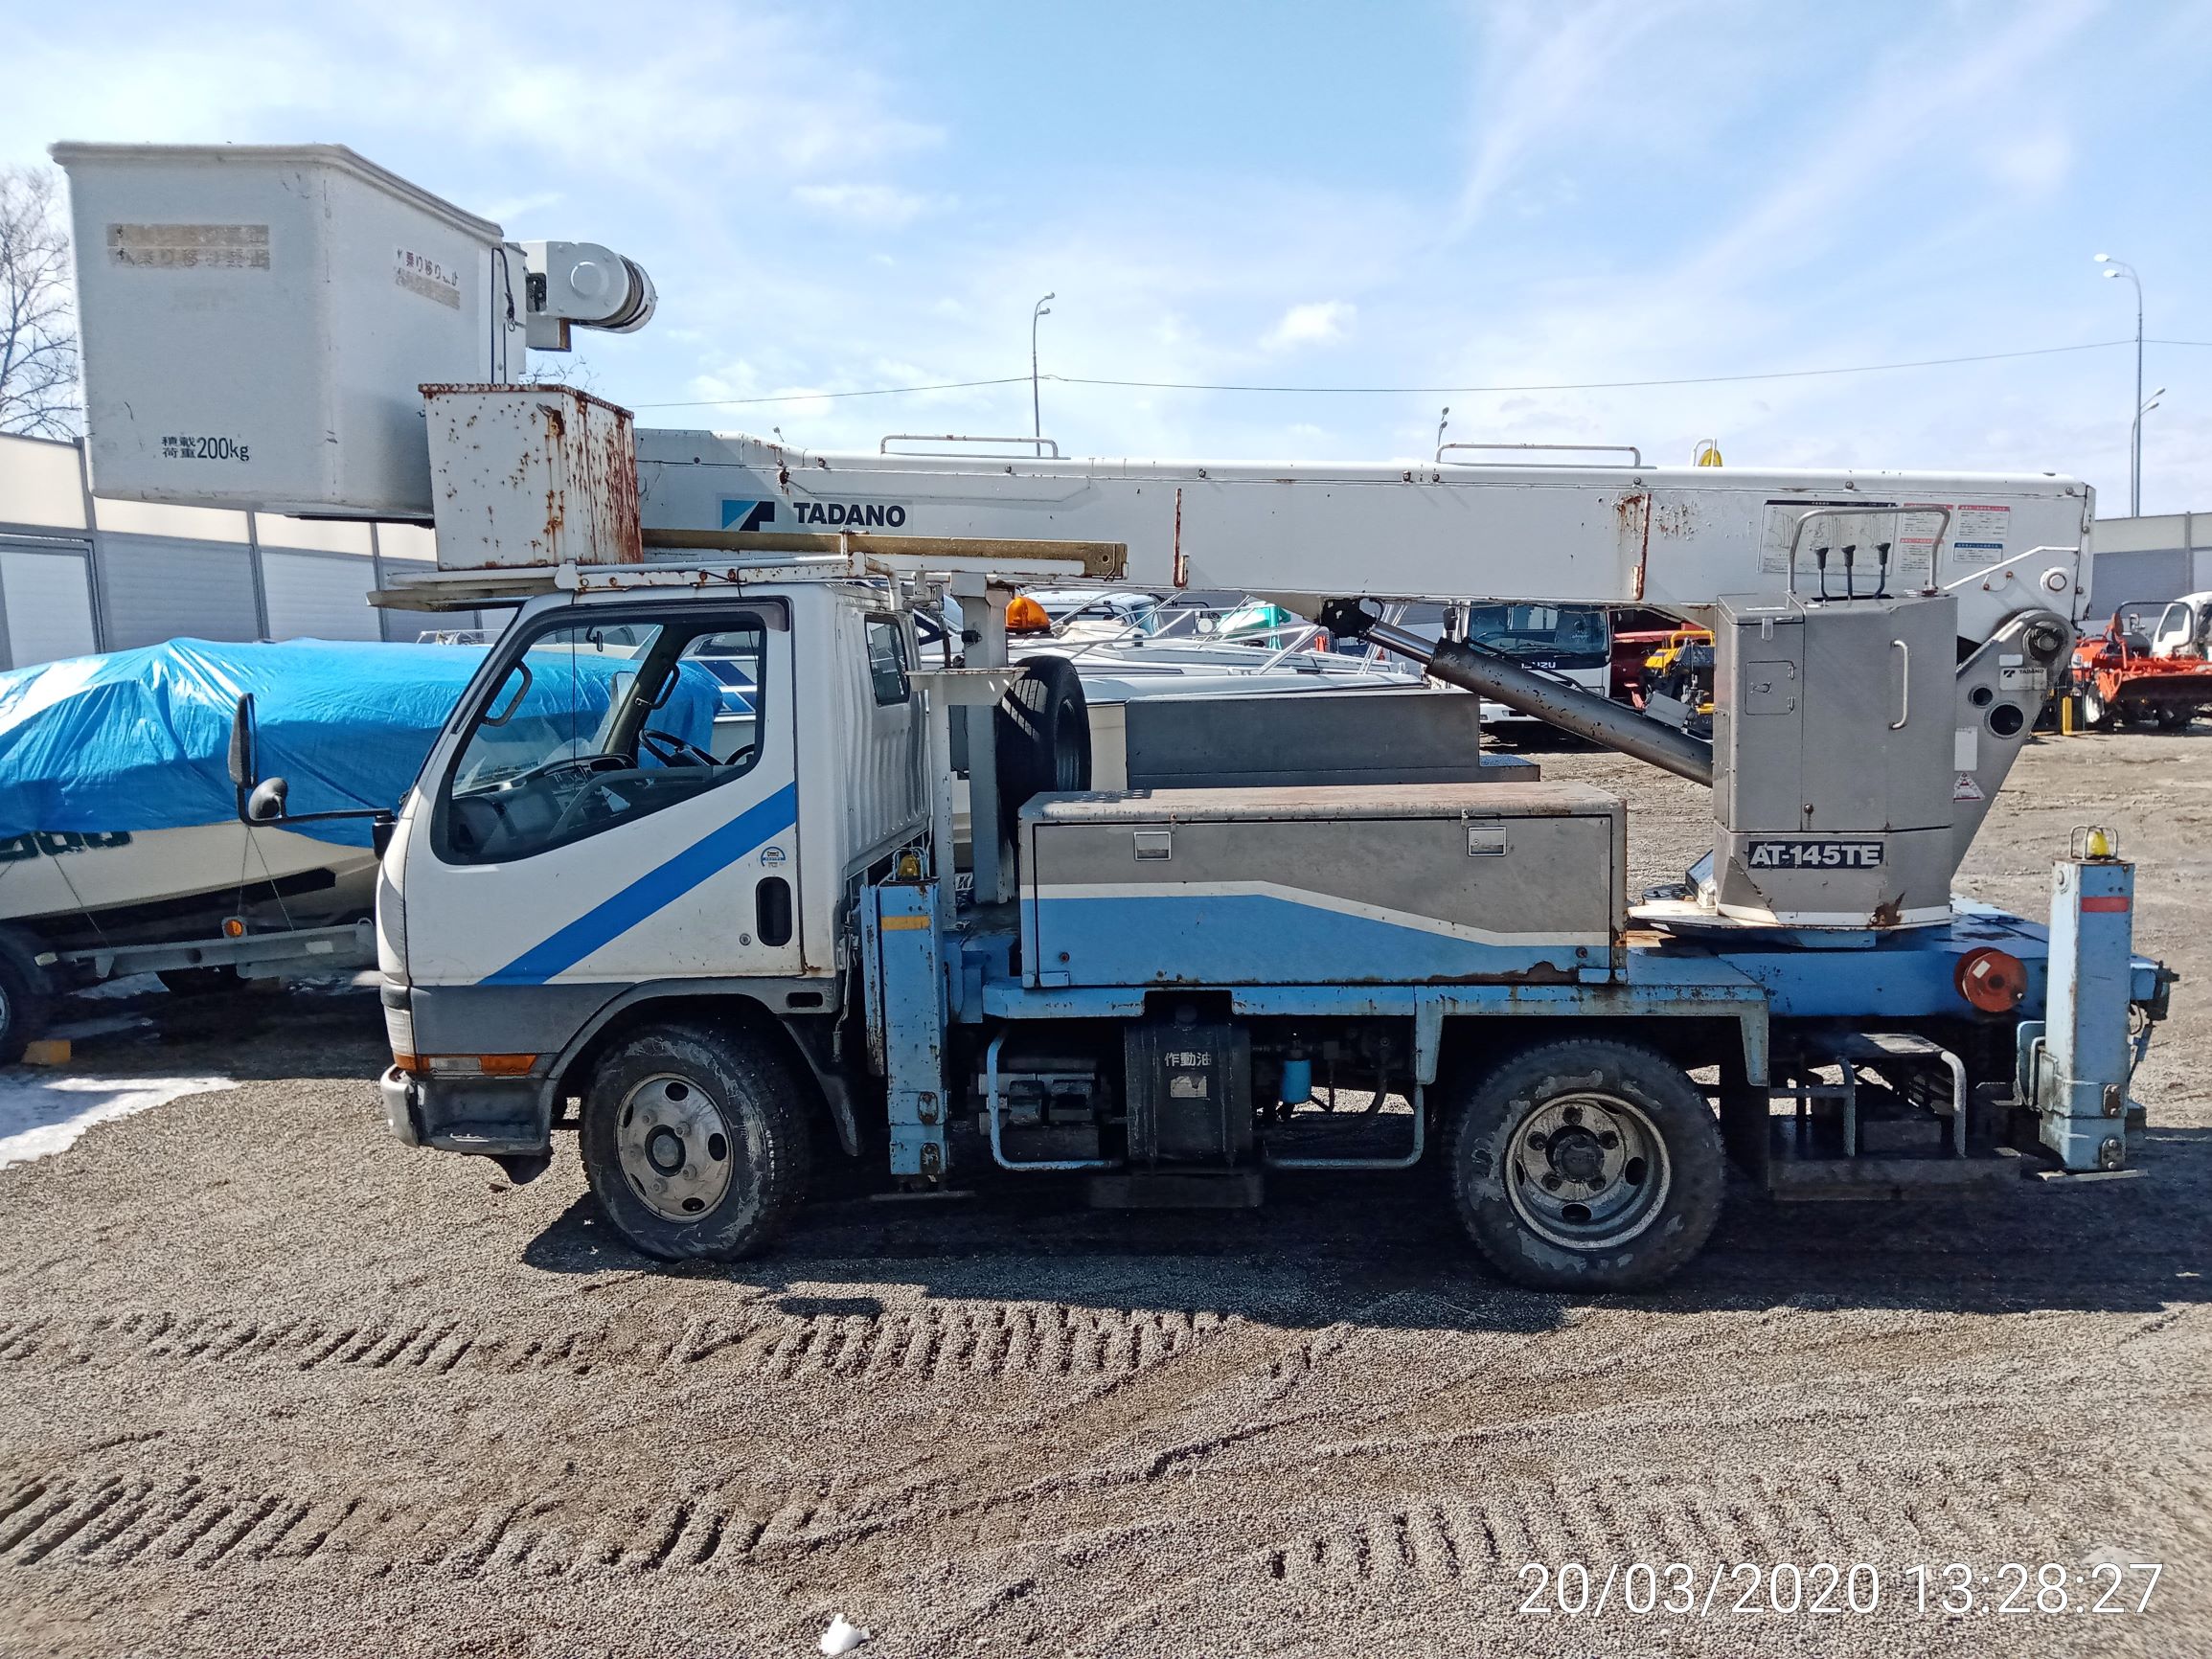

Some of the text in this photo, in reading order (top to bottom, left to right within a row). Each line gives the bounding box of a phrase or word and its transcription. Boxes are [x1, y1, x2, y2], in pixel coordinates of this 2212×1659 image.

[196, 437, 250, 462] 200kg
[792, 502, 906, 528] TADANO
[1749, 844, 1881, 866] AT-145TE
[1164, 1051, 1212, 1067] 作動油
